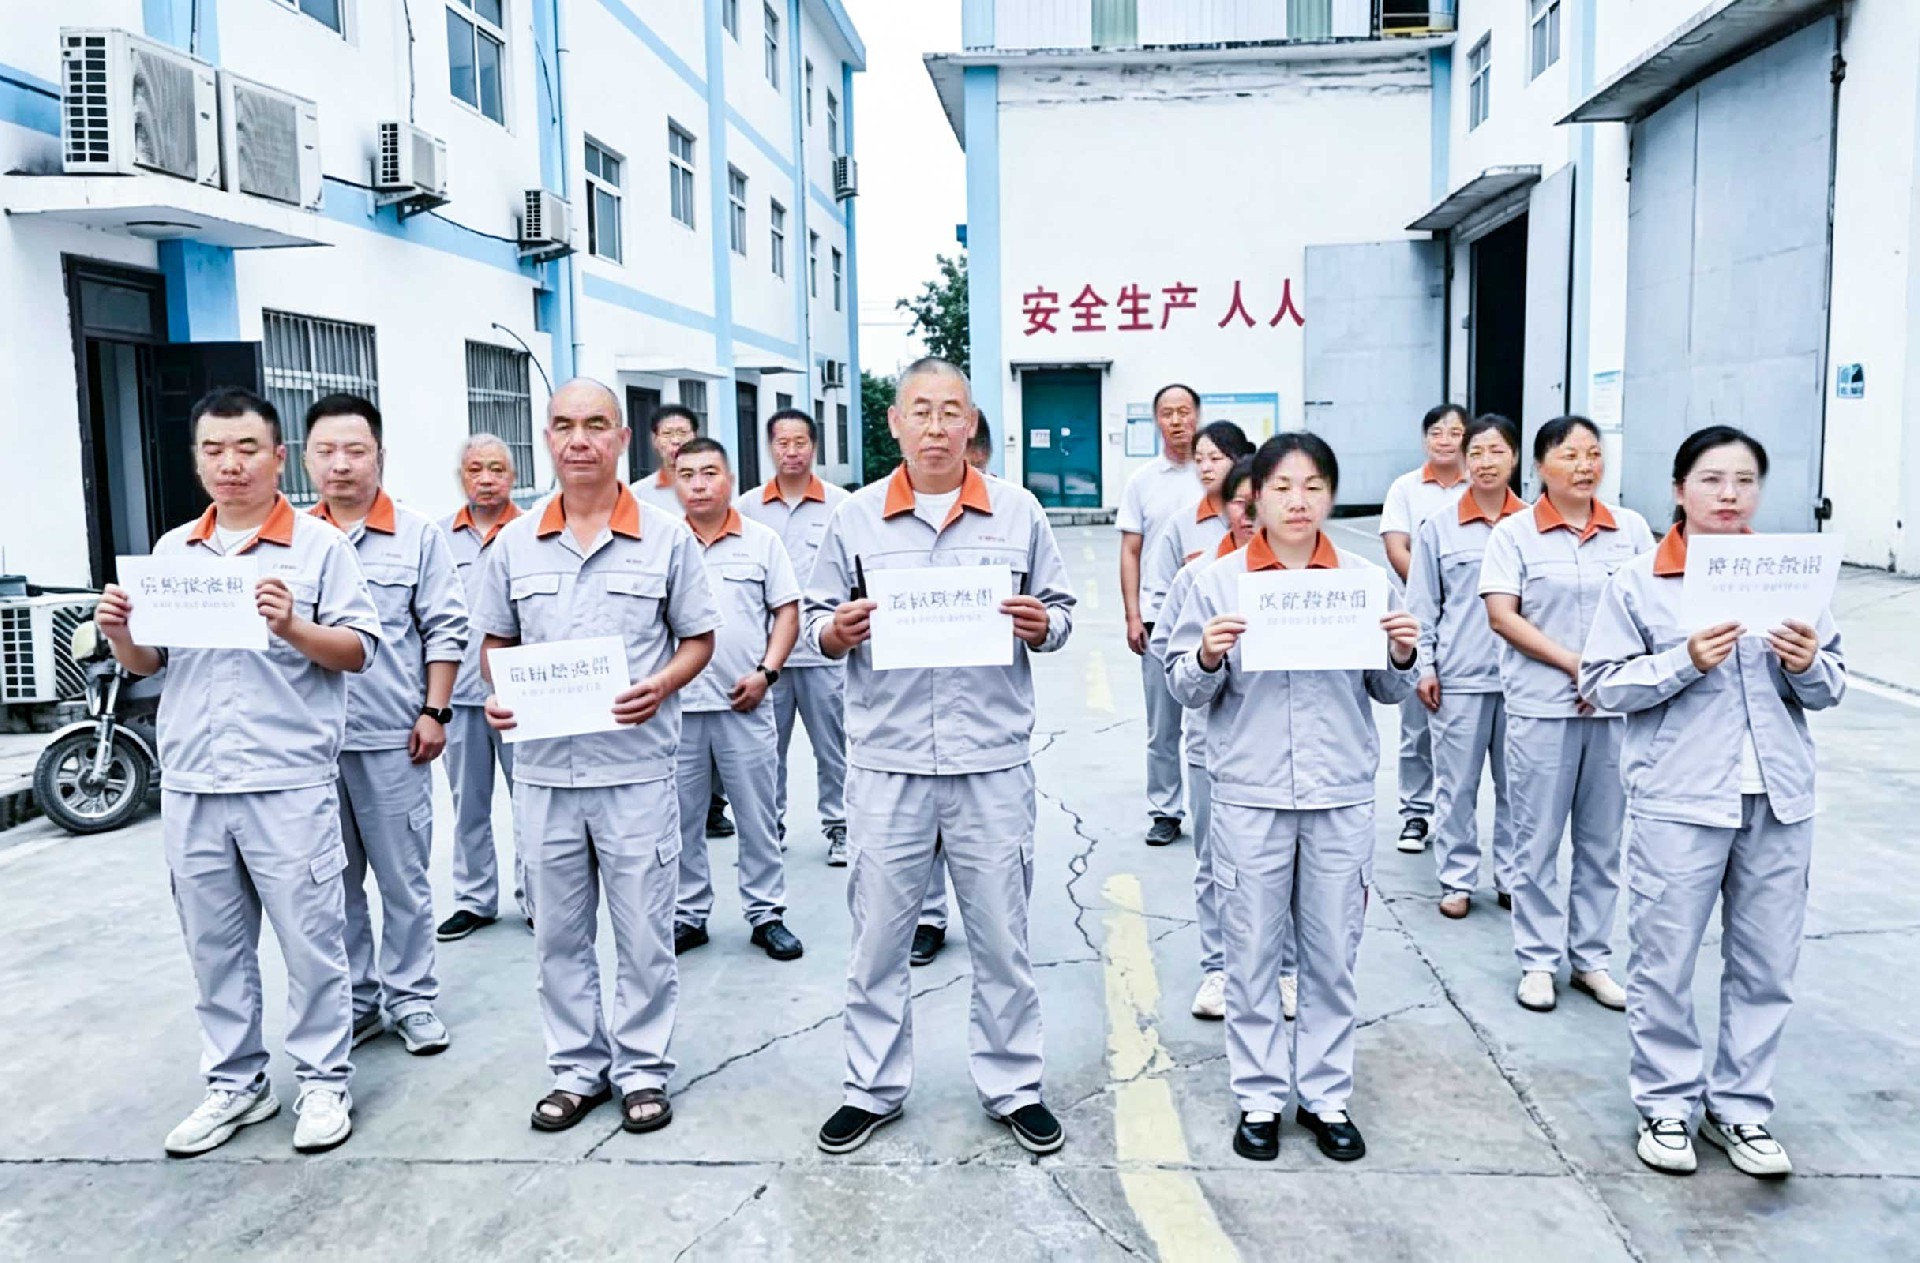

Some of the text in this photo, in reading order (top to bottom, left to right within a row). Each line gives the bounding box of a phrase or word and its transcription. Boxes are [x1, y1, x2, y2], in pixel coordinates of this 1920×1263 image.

[1022, 278, 1305, 336] 安全生产 人人
